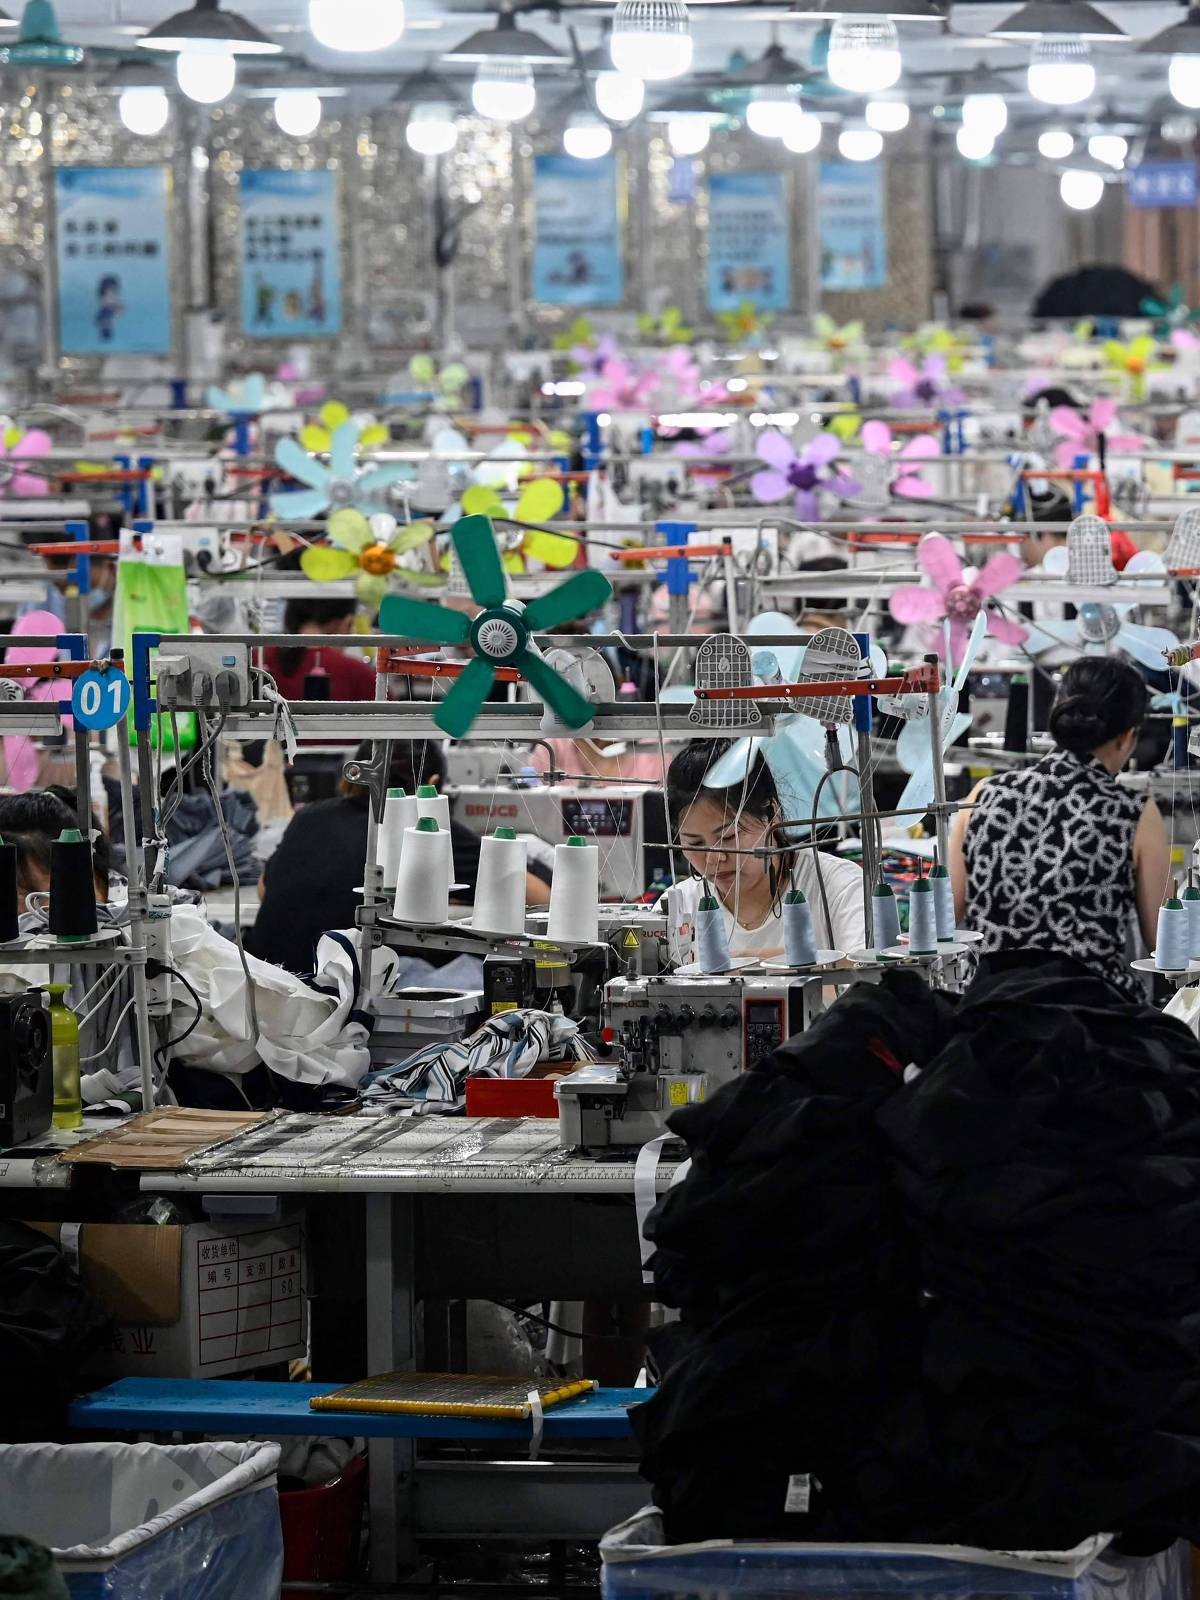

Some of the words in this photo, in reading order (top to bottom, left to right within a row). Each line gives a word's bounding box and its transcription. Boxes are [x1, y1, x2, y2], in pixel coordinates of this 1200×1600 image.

[81, 680, 121, 715] 01
[465, 804, 519, 817] BRUCE
[202, 1242, 237, 1260] 收货单位
